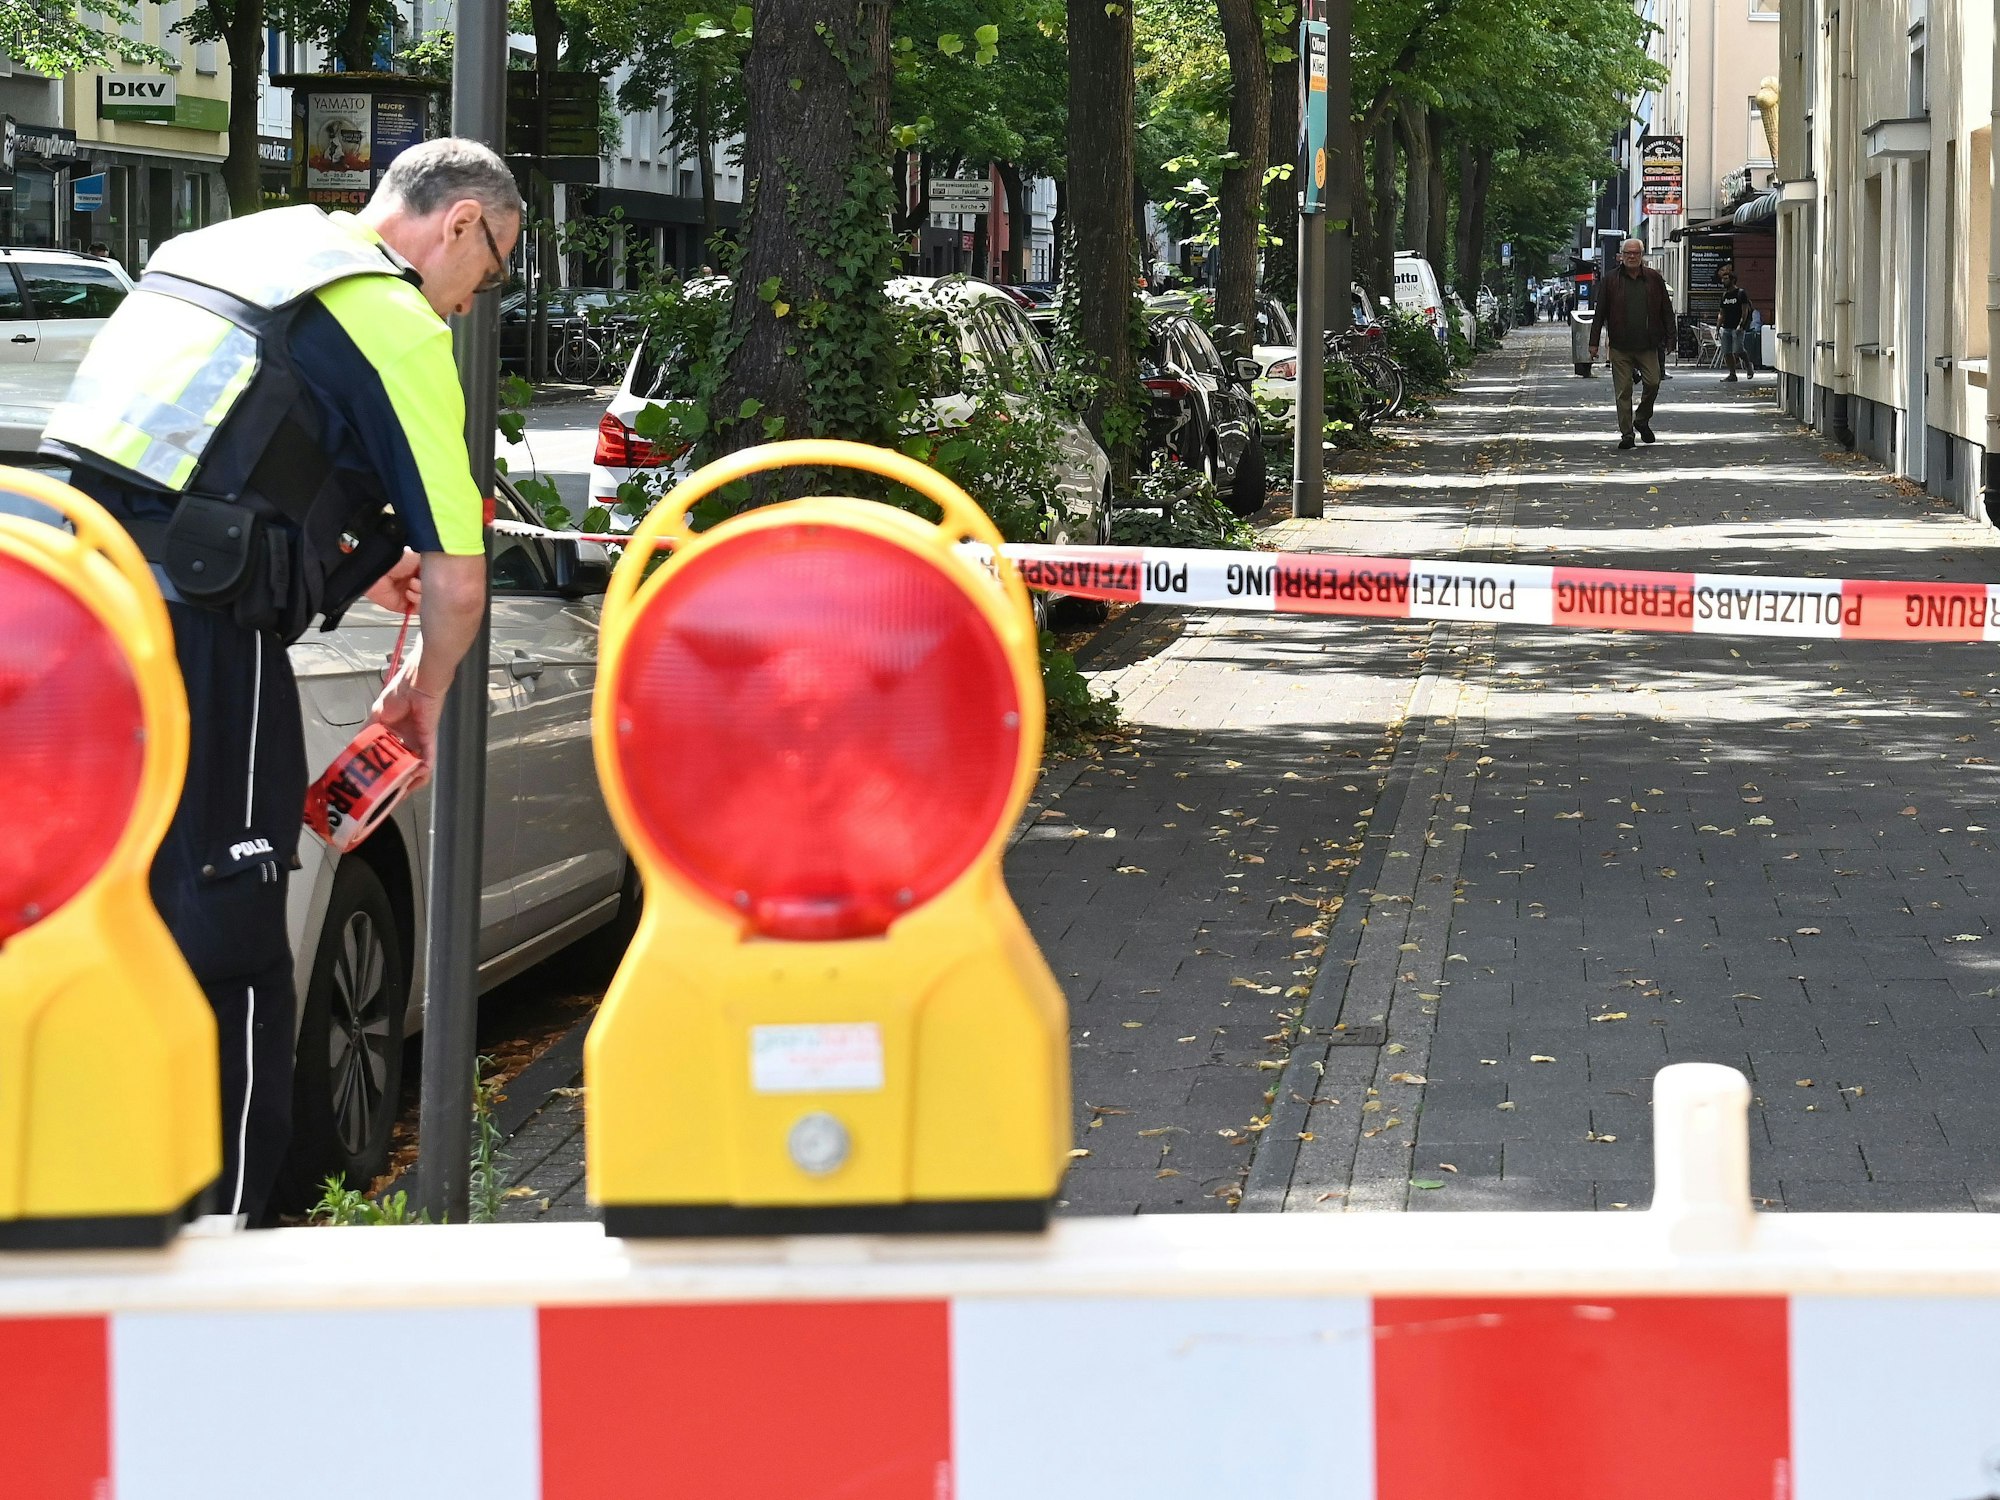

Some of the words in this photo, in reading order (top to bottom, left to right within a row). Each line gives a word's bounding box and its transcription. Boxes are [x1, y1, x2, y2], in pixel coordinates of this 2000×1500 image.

[108, 82, 166, 98] DKV
[314, 97, 365, 110] YAMATO
[1227, 562, 1516, 611] POLIZEIABSPERRUNG
[1557, 579, 1863, 627] POLIZEIABSPERRUNG
[229, 837, 274, 862] POLIZ
